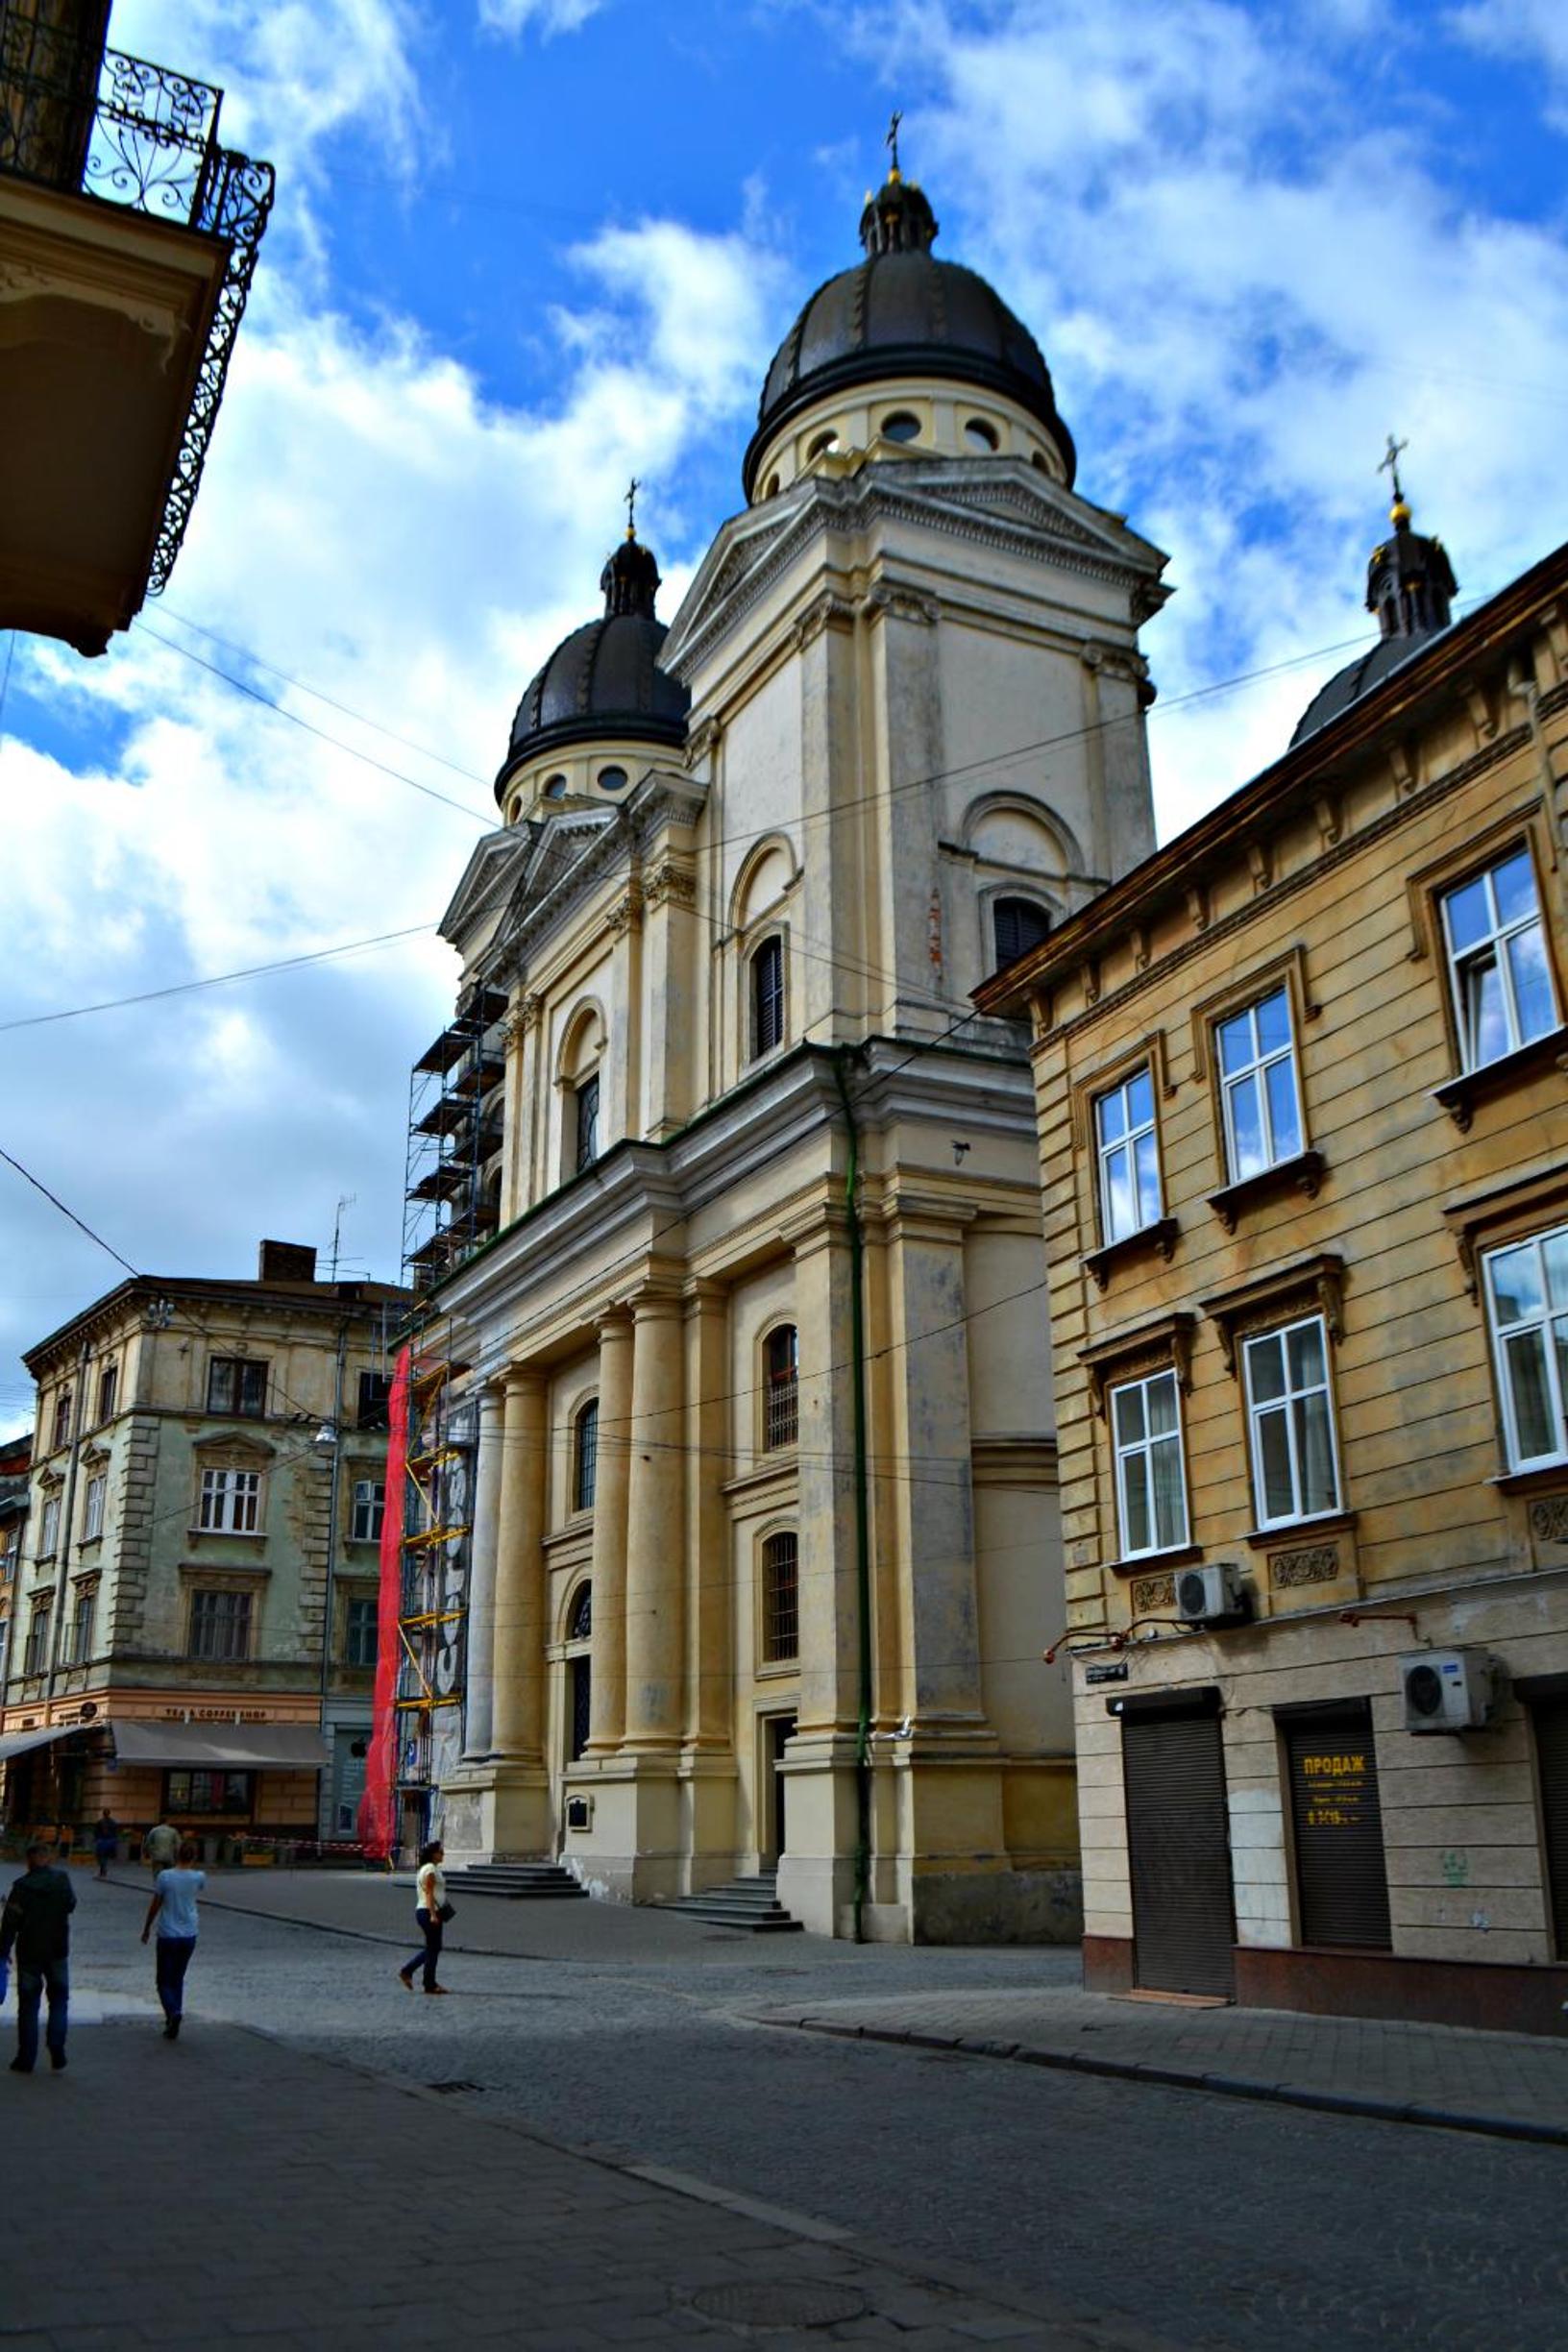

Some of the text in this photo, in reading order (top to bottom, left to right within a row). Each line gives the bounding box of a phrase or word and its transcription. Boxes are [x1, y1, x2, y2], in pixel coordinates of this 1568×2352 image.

[166, 1708, 184, 1717] TEA
[199, 1708, 236, 1718] COFFEE
[1304, 1755, 1364, 1776] ПРОДАЖ
